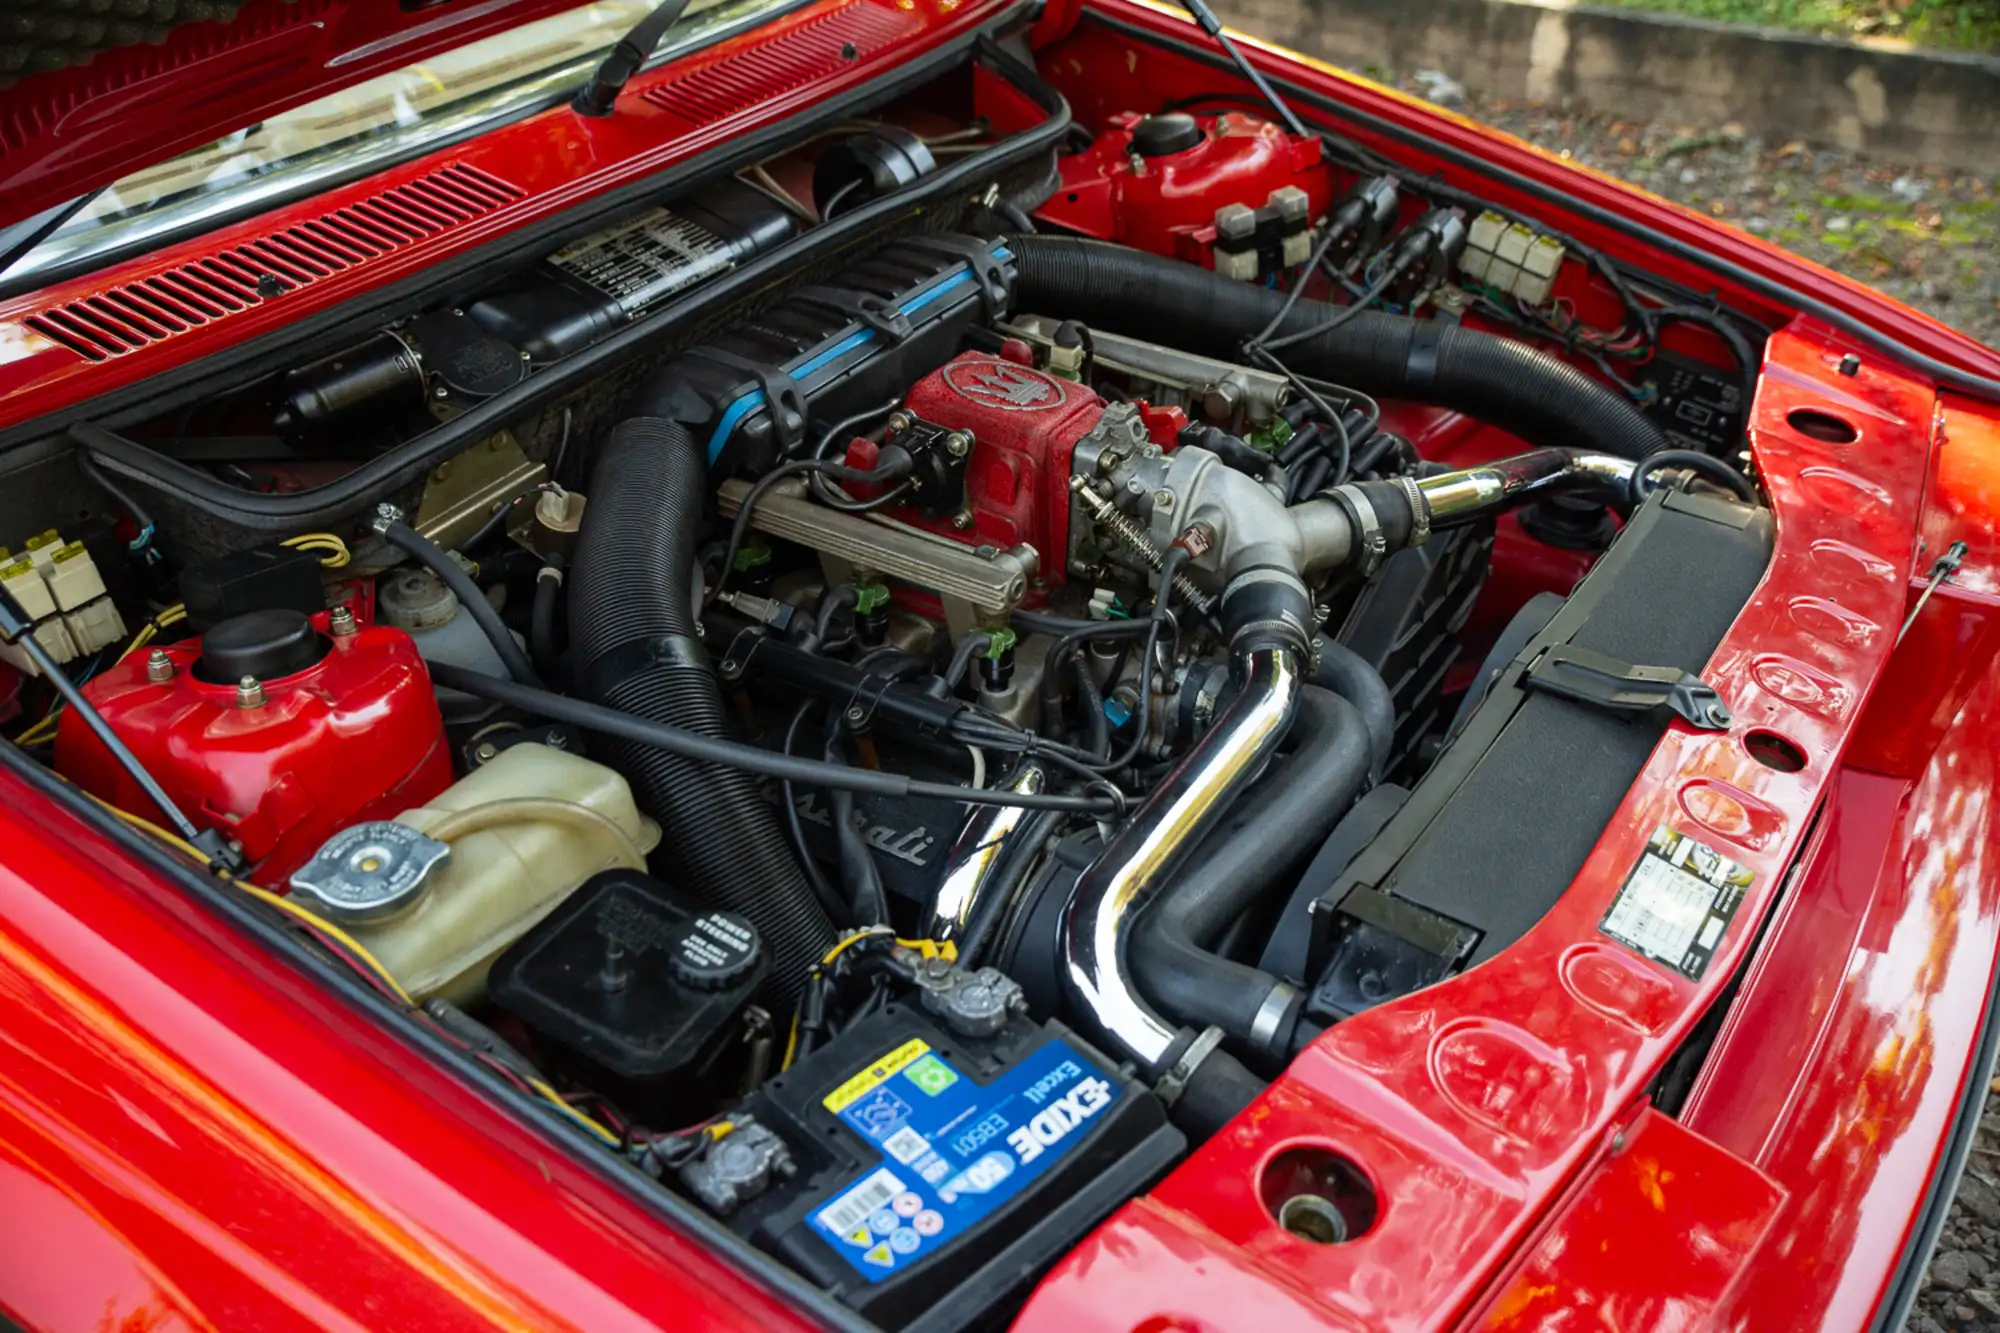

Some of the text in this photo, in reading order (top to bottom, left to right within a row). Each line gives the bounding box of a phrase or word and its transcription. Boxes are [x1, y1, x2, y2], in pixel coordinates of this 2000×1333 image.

[694, 918, 750, 953] STEERING
[710, 913, 752, 941] POWER
[1022, 1060, 1081, 1104] Excell
[952, 1113, 1009, 1158] EB501
[1007, 1075, 1113, 1166] EXIDE
